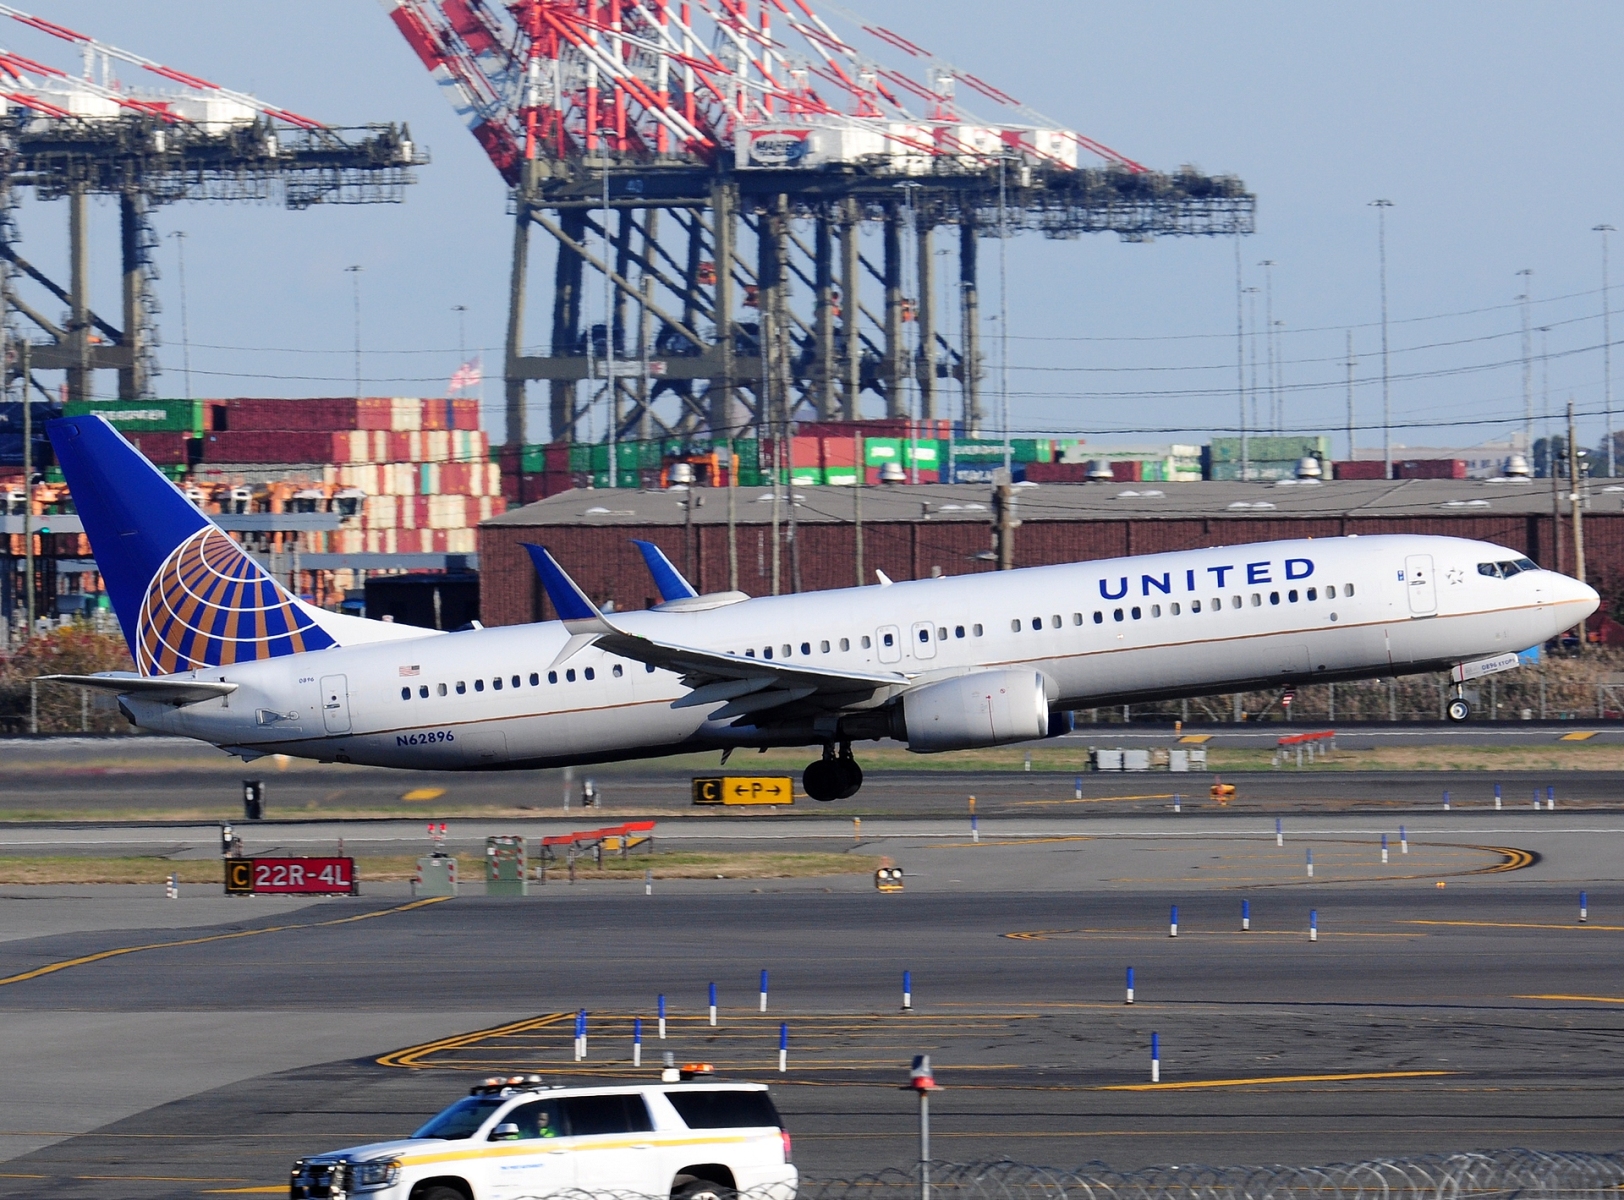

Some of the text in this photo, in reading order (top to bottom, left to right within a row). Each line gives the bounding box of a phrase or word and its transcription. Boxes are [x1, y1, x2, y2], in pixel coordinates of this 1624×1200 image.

[1099, 558, 1315, 600] UNITED
[396, 730, 455, 747] N62896
[702, 782, 763, 800] C P
[232, 864, 351, 886] C 22R-4L
